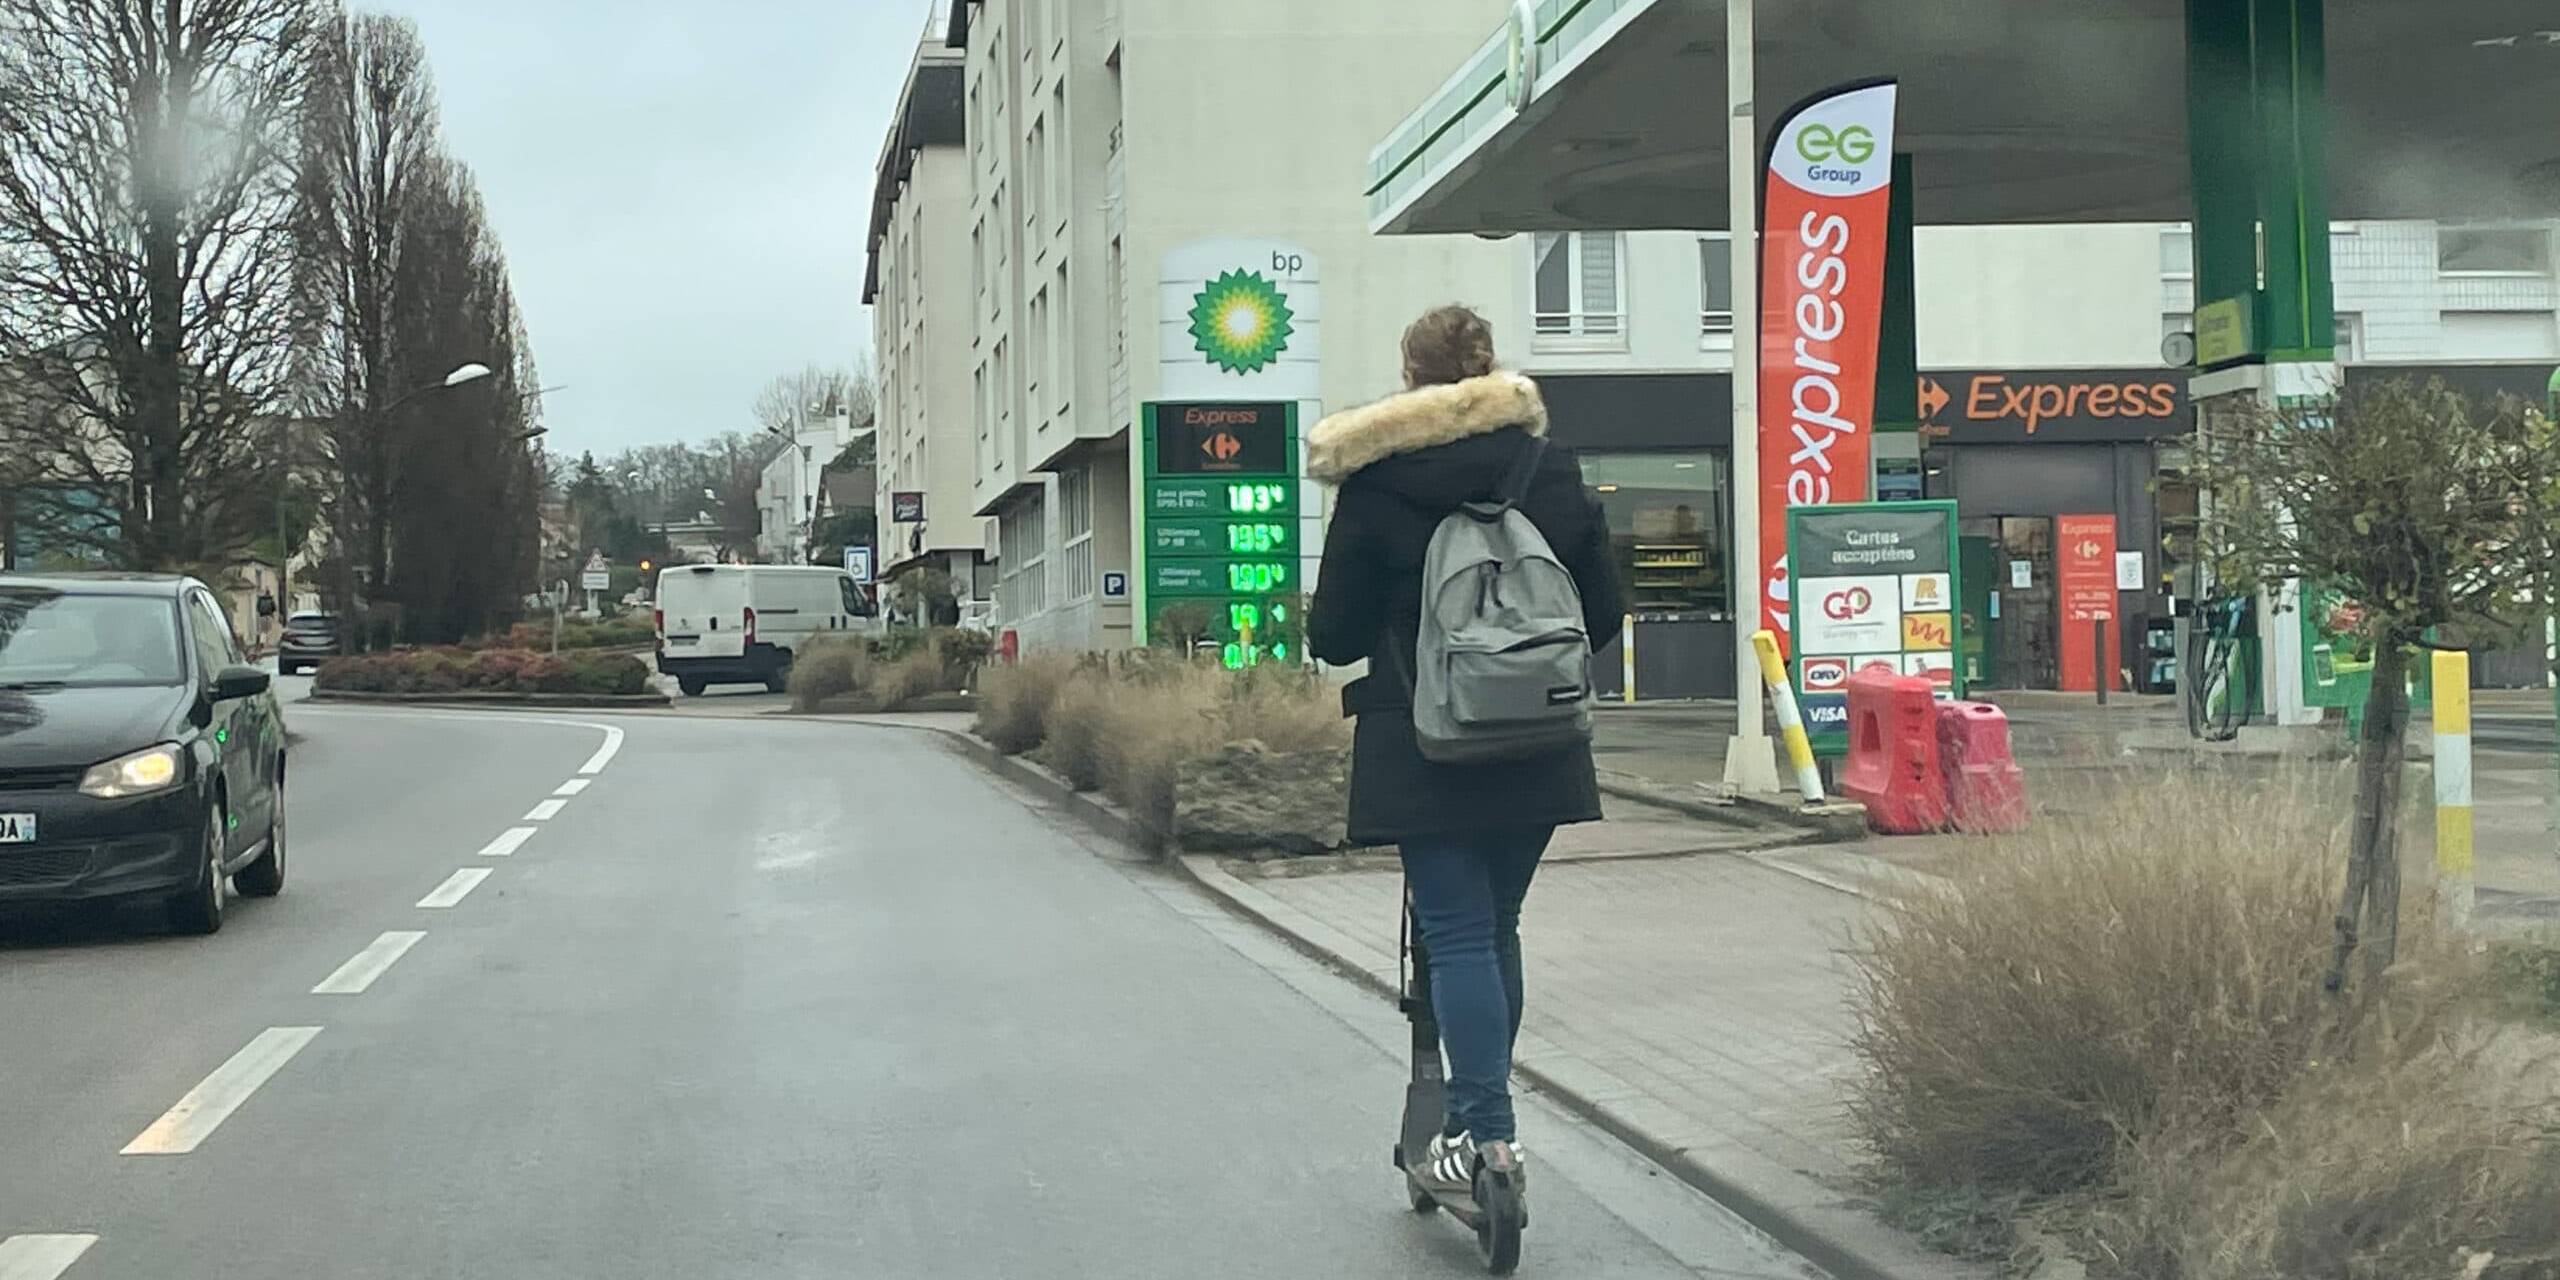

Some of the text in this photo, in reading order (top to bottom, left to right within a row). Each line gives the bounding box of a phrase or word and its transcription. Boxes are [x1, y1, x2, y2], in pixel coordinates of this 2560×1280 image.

[1807, 164, 1862, 185] Group
[1272, 250, 1302, 276] bp
[1966, 374, 2177, 434] Express
[1185, 408, 1258, 426] Express
[1846, 530, 1900, 545] Cartes
[1108, 576, 1122, 593] P
[1808, 706, 1848, 723] VISA
